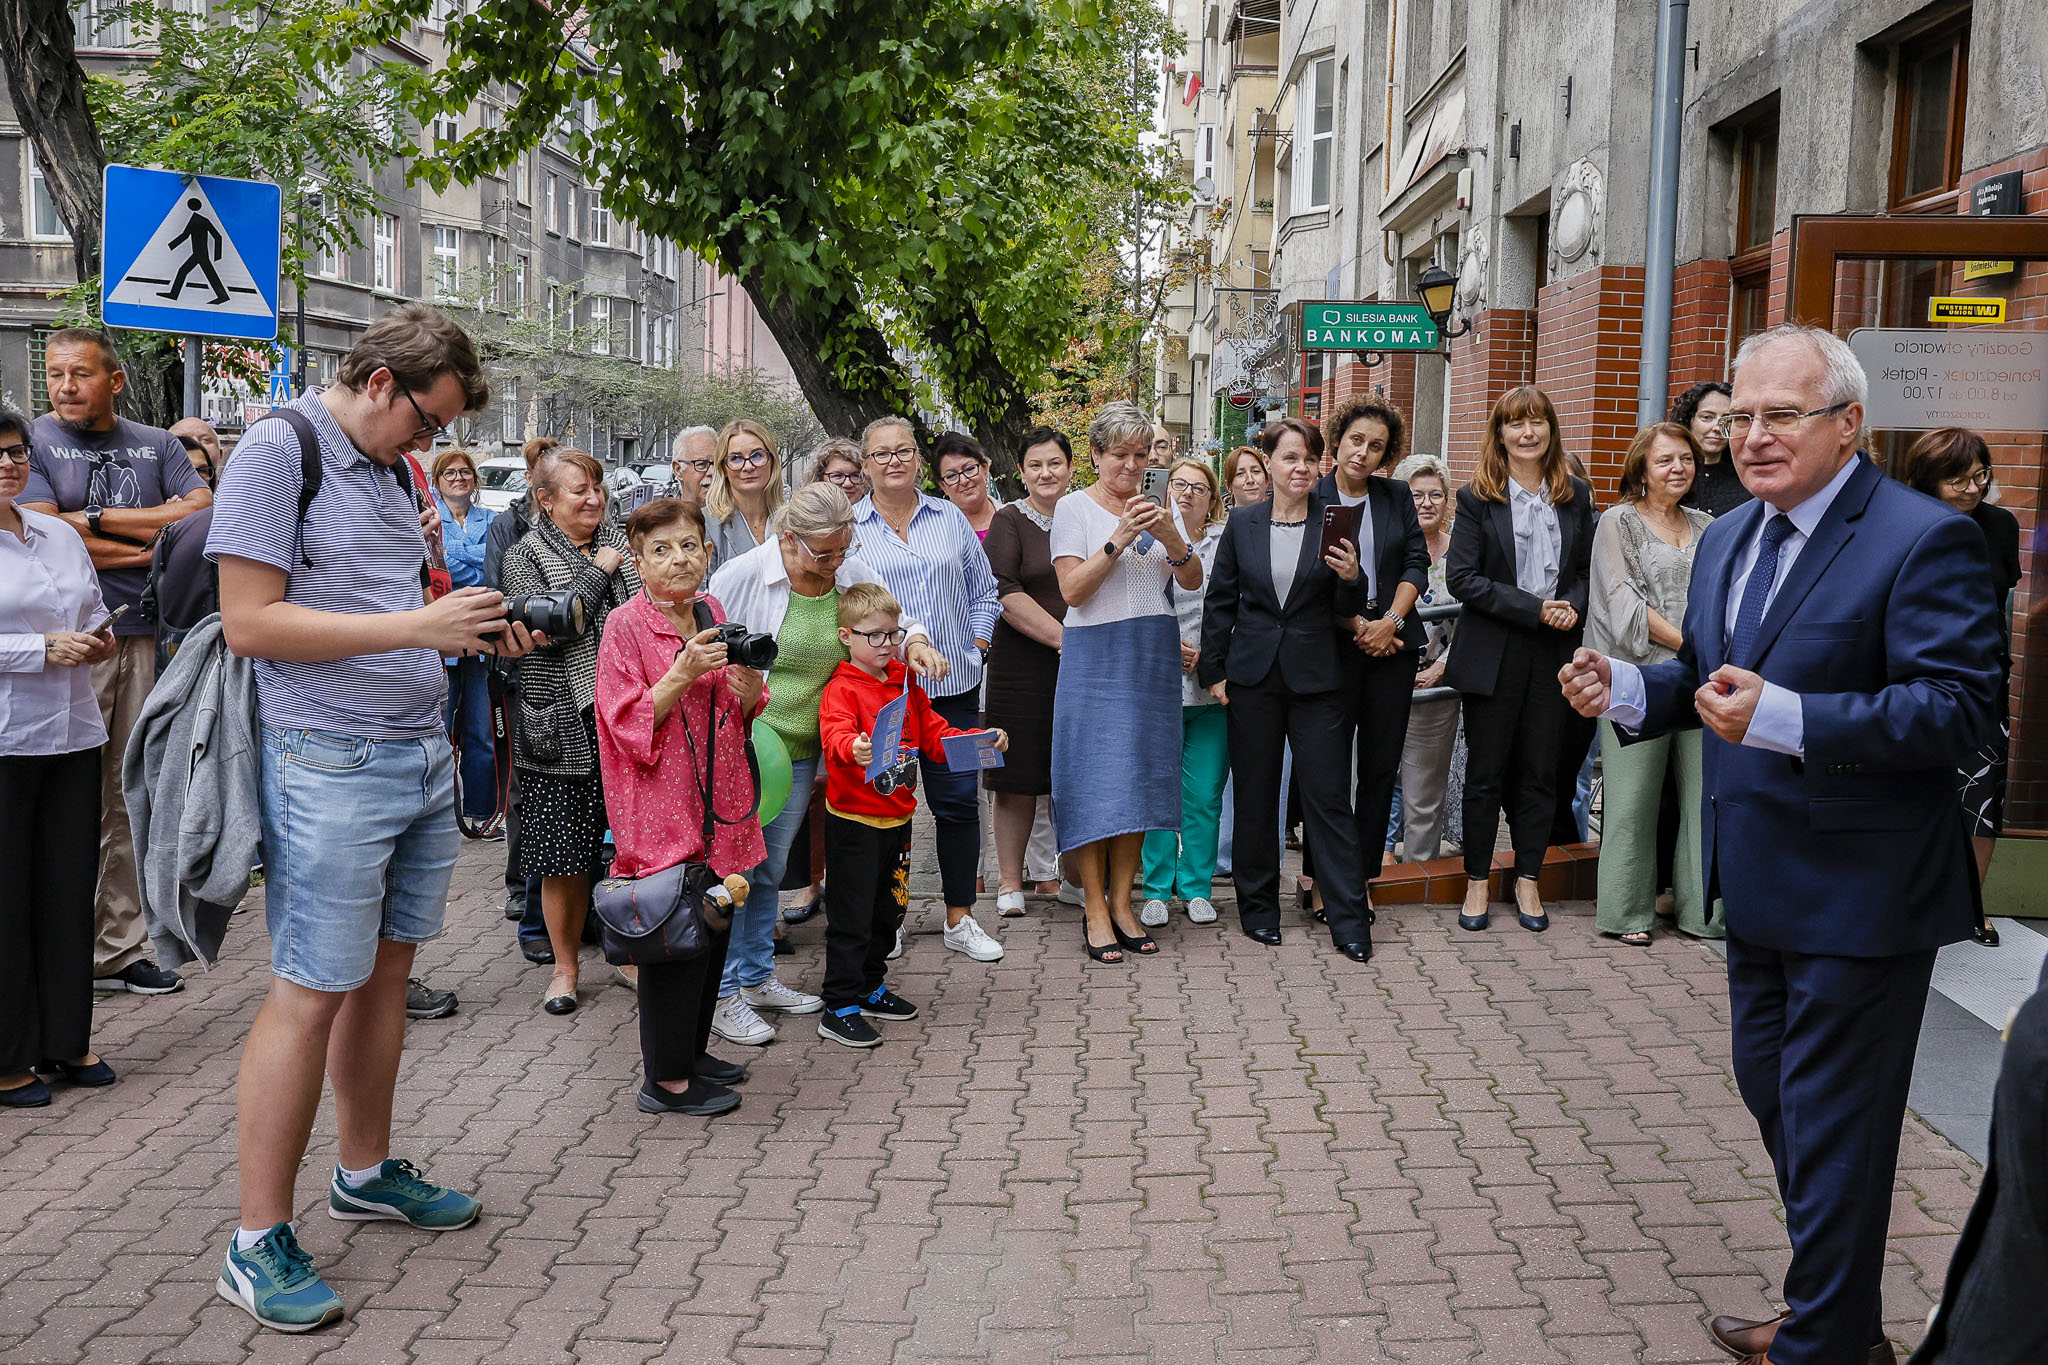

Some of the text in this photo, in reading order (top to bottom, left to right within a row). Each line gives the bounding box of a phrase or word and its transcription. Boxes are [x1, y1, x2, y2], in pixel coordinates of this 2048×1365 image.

[1345, 313, 1418, 324] SILESIA BANK
[1306, 329, 1435, 344] BANKOMAT
[126, 445, 158, 463] ME
[495, 706, 505, 738] Canon
